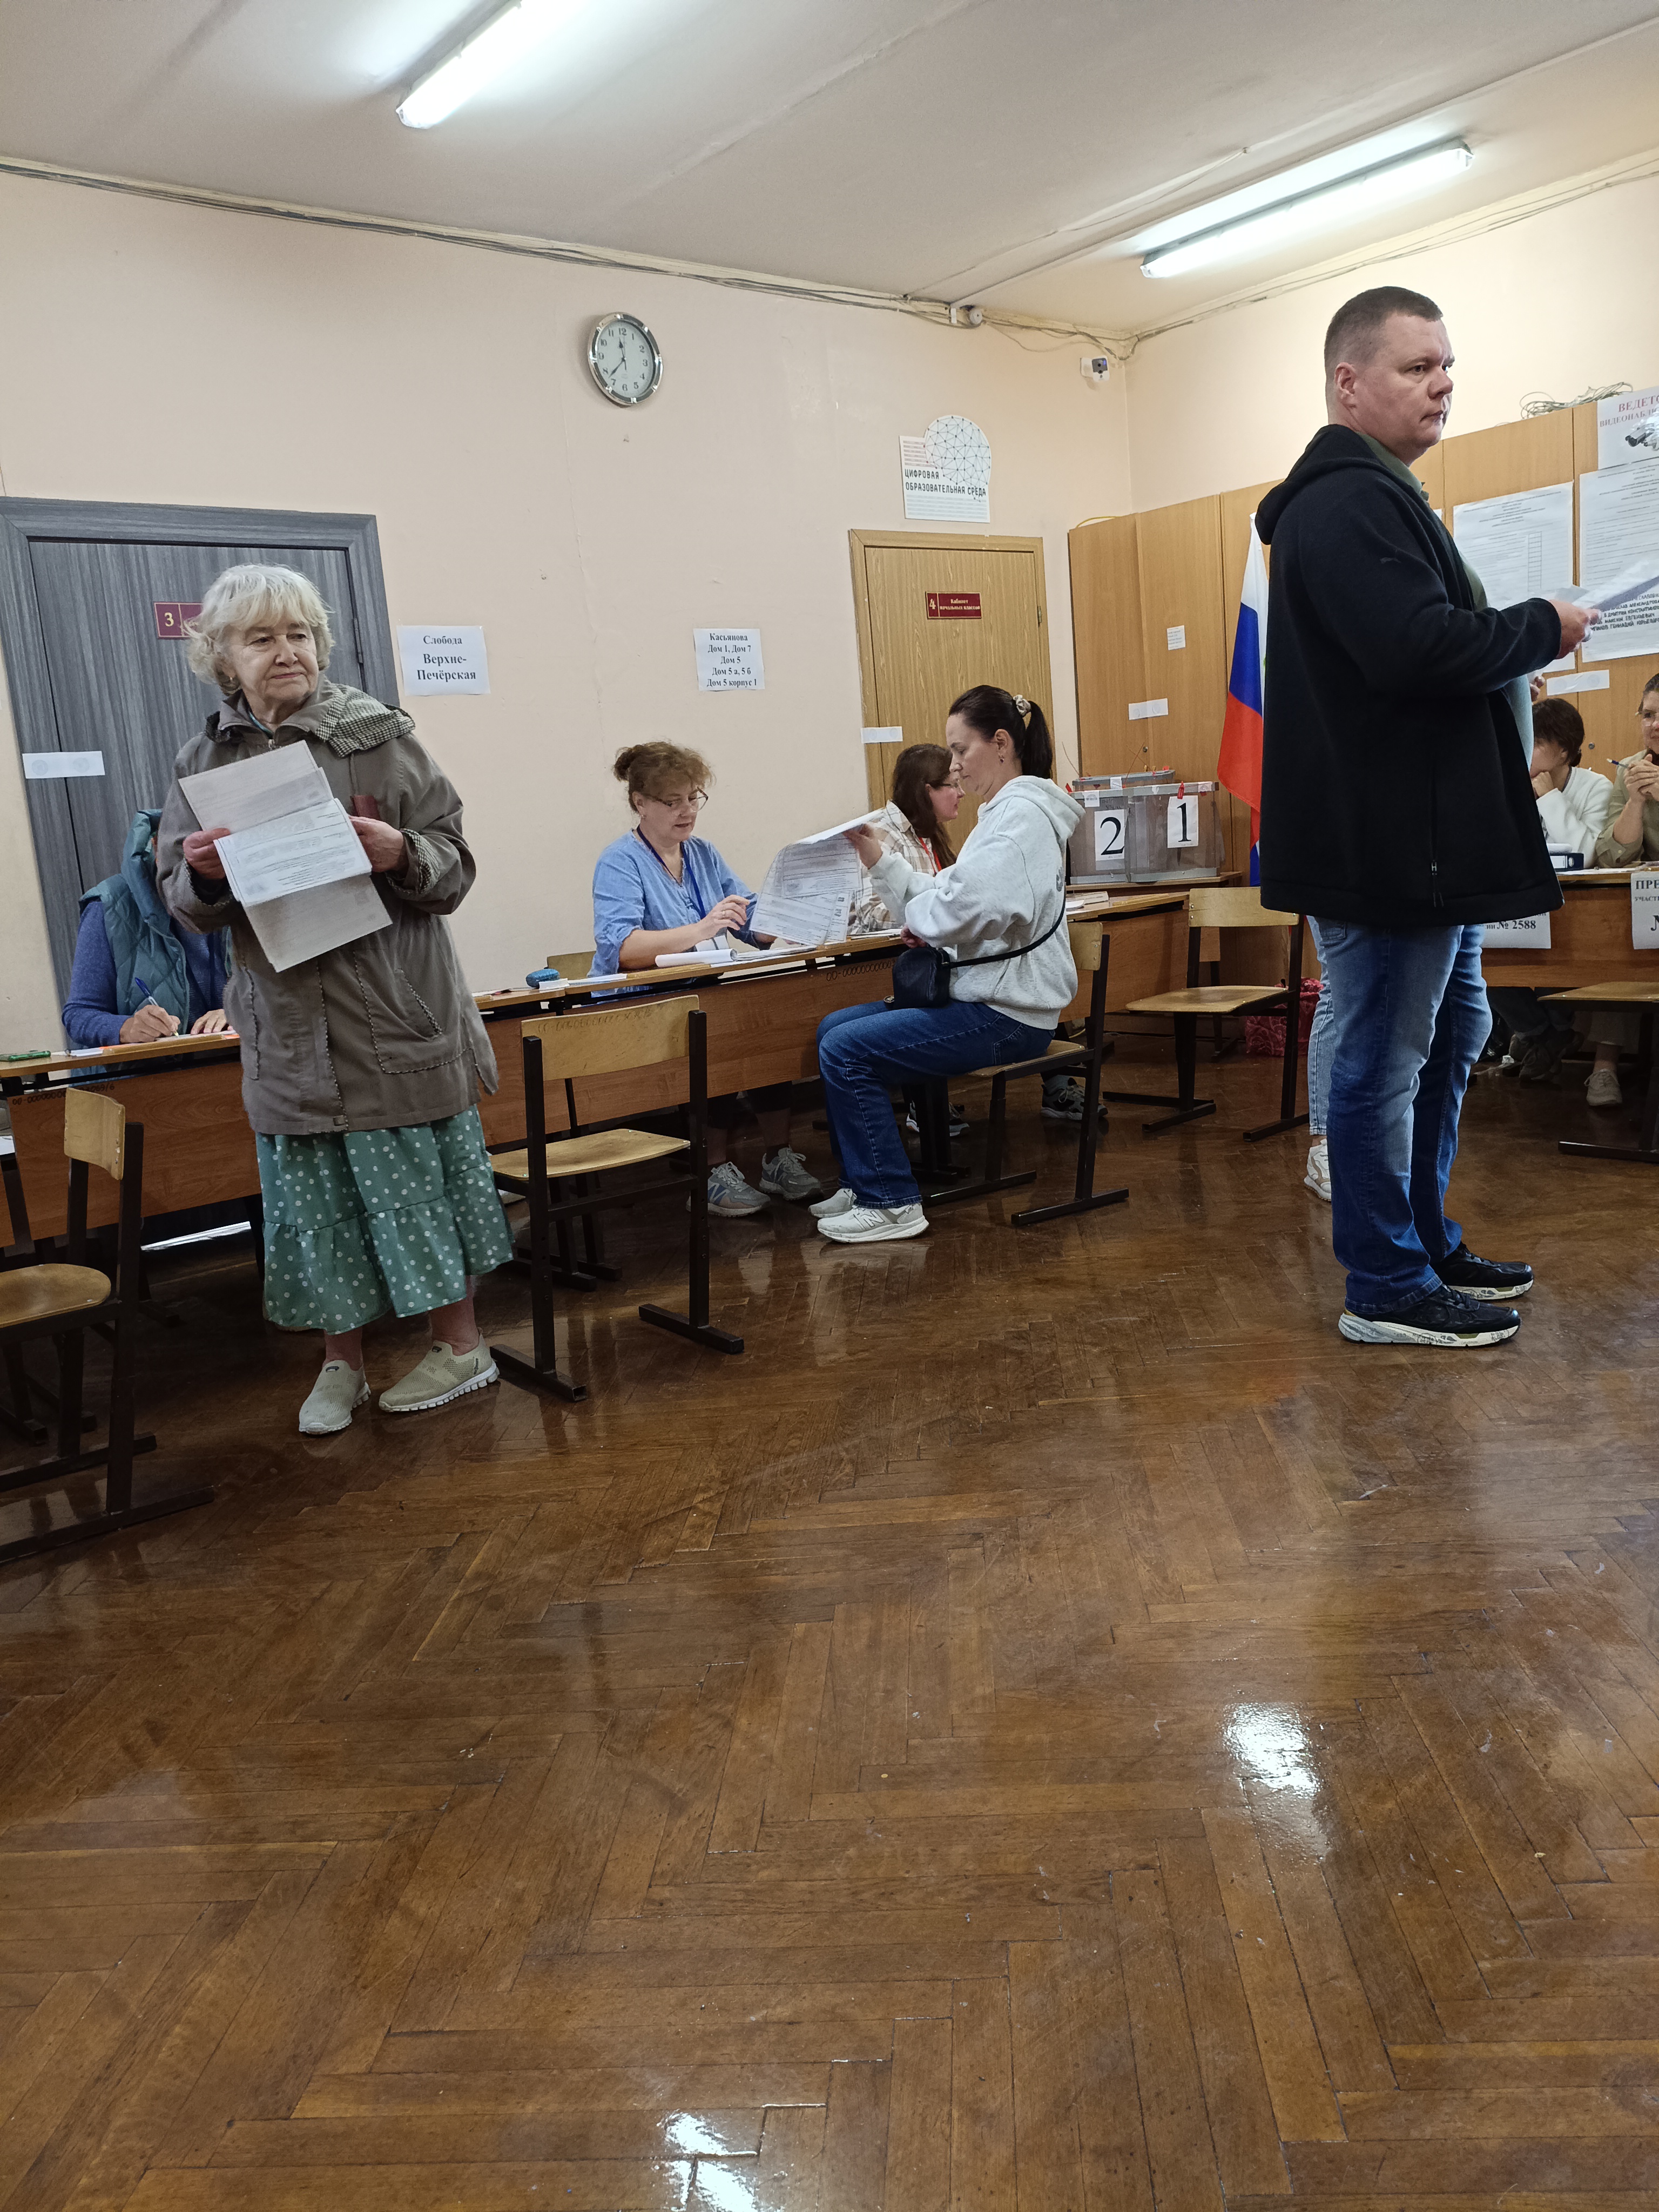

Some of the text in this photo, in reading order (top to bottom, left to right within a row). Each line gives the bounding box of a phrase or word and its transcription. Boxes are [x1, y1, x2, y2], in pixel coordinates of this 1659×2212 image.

[608, 329, 614, 337] 11
[618, 328, 627, 336] 12
[639, 345, 645, 353] 2
[602, 367, 609, 375] 8
[905, 469, 939, 479] ЦИФРОВАЯ
[906, 482, 986, 497] ОБРАЗОВАТЕЛЬНАЯ СРЕДА
[929, 598, 936, 610] 4
[164, 612, 174, 627] 3
[423, 635, 462, 645] Слобода
[710, 633, 748, 641] Касьянова
[707, 645, 722, 653] Дом
[725, 645, 730, 654] 1,
[732, 645, 746, 653] Дом
[423, 653, 467, 666] Верхне-
[720, 656, 735, 664] Дом
[712, 667, 726, 676] Дом
[417, 670, 476, 683] Печёрская
[706, 679, 721, 687] Дом
[1177, 802, 1191, 842] 1
[1100, 817, 1124, 855] 2
[1497, 921, 1509, 929] №
[1512, 920, 1536, 929] 2588
